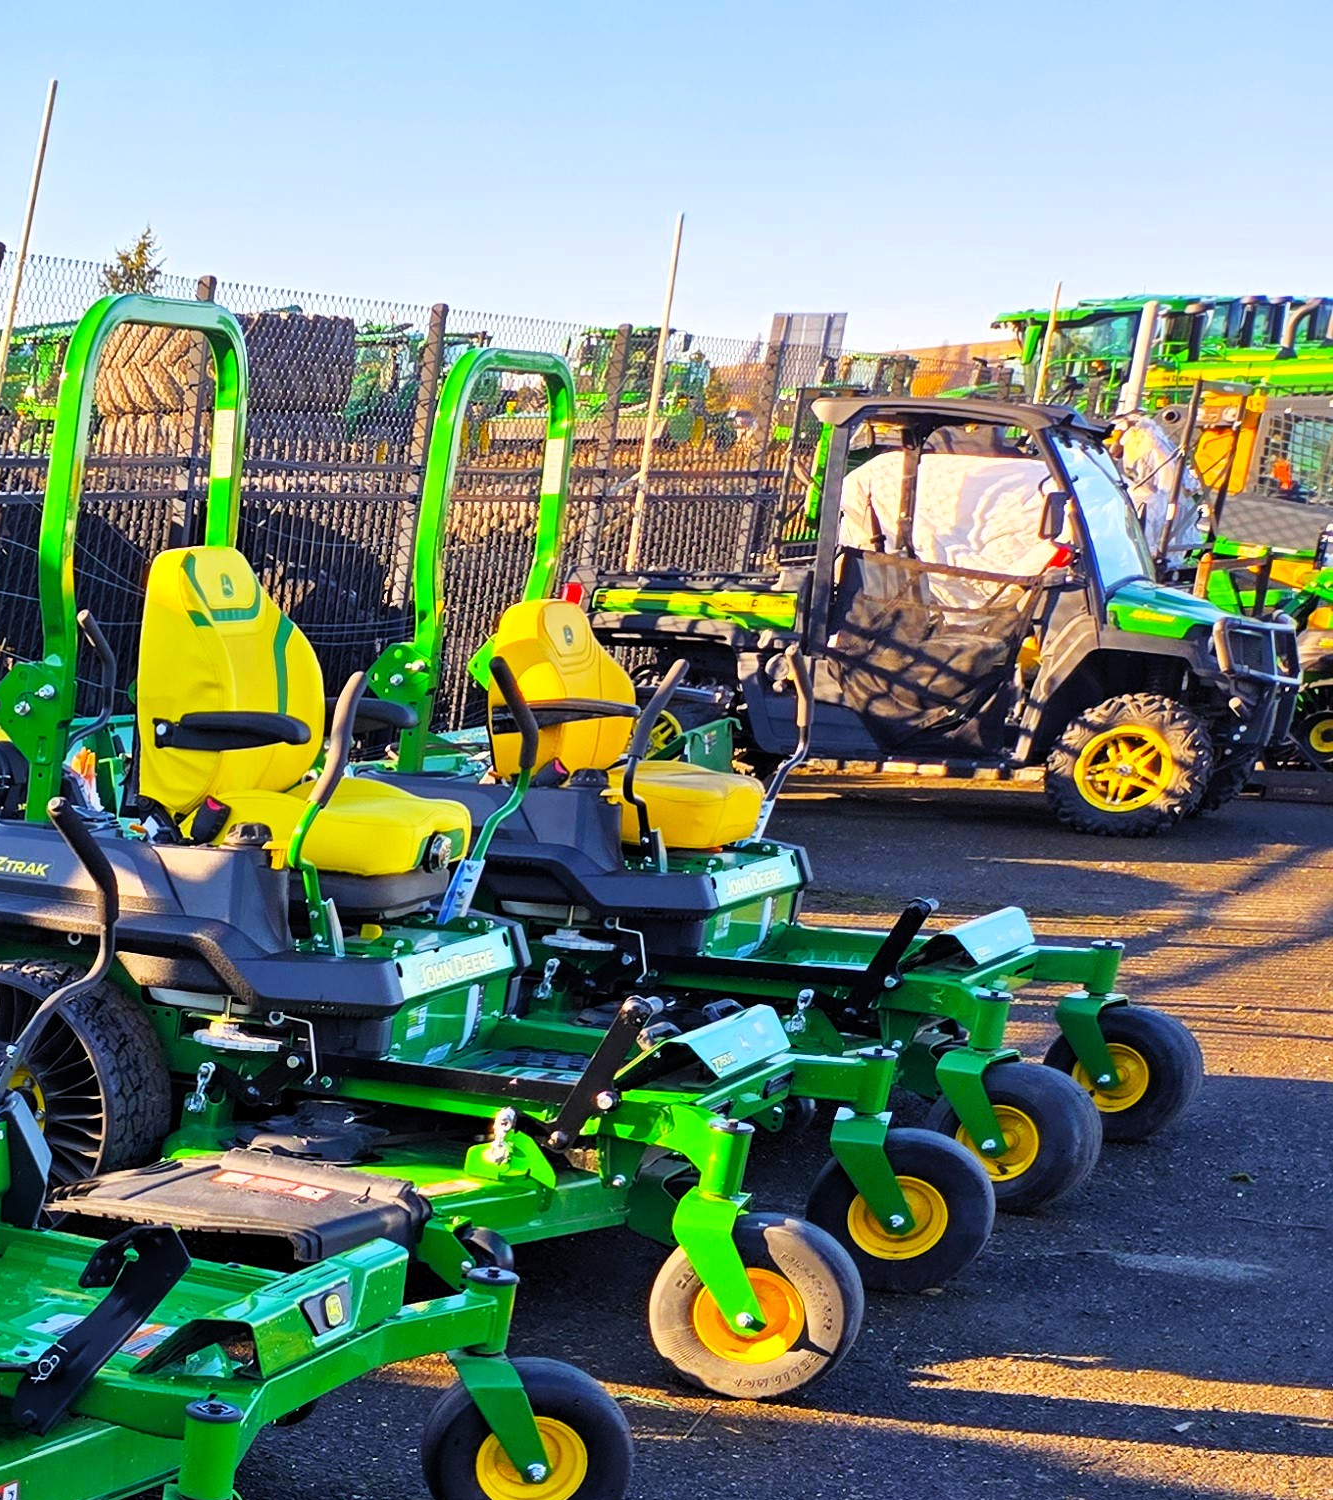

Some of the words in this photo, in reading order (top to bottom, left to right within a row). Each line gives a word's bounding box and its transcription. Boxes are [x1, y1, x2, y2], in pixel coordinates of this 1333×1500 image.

[726, 874, 753, 899] JOHN
[751, 867, 784, 891] DEERE
[419, 959, 453, 990] JOHN
[452, 948, 498, 978] DEERE
